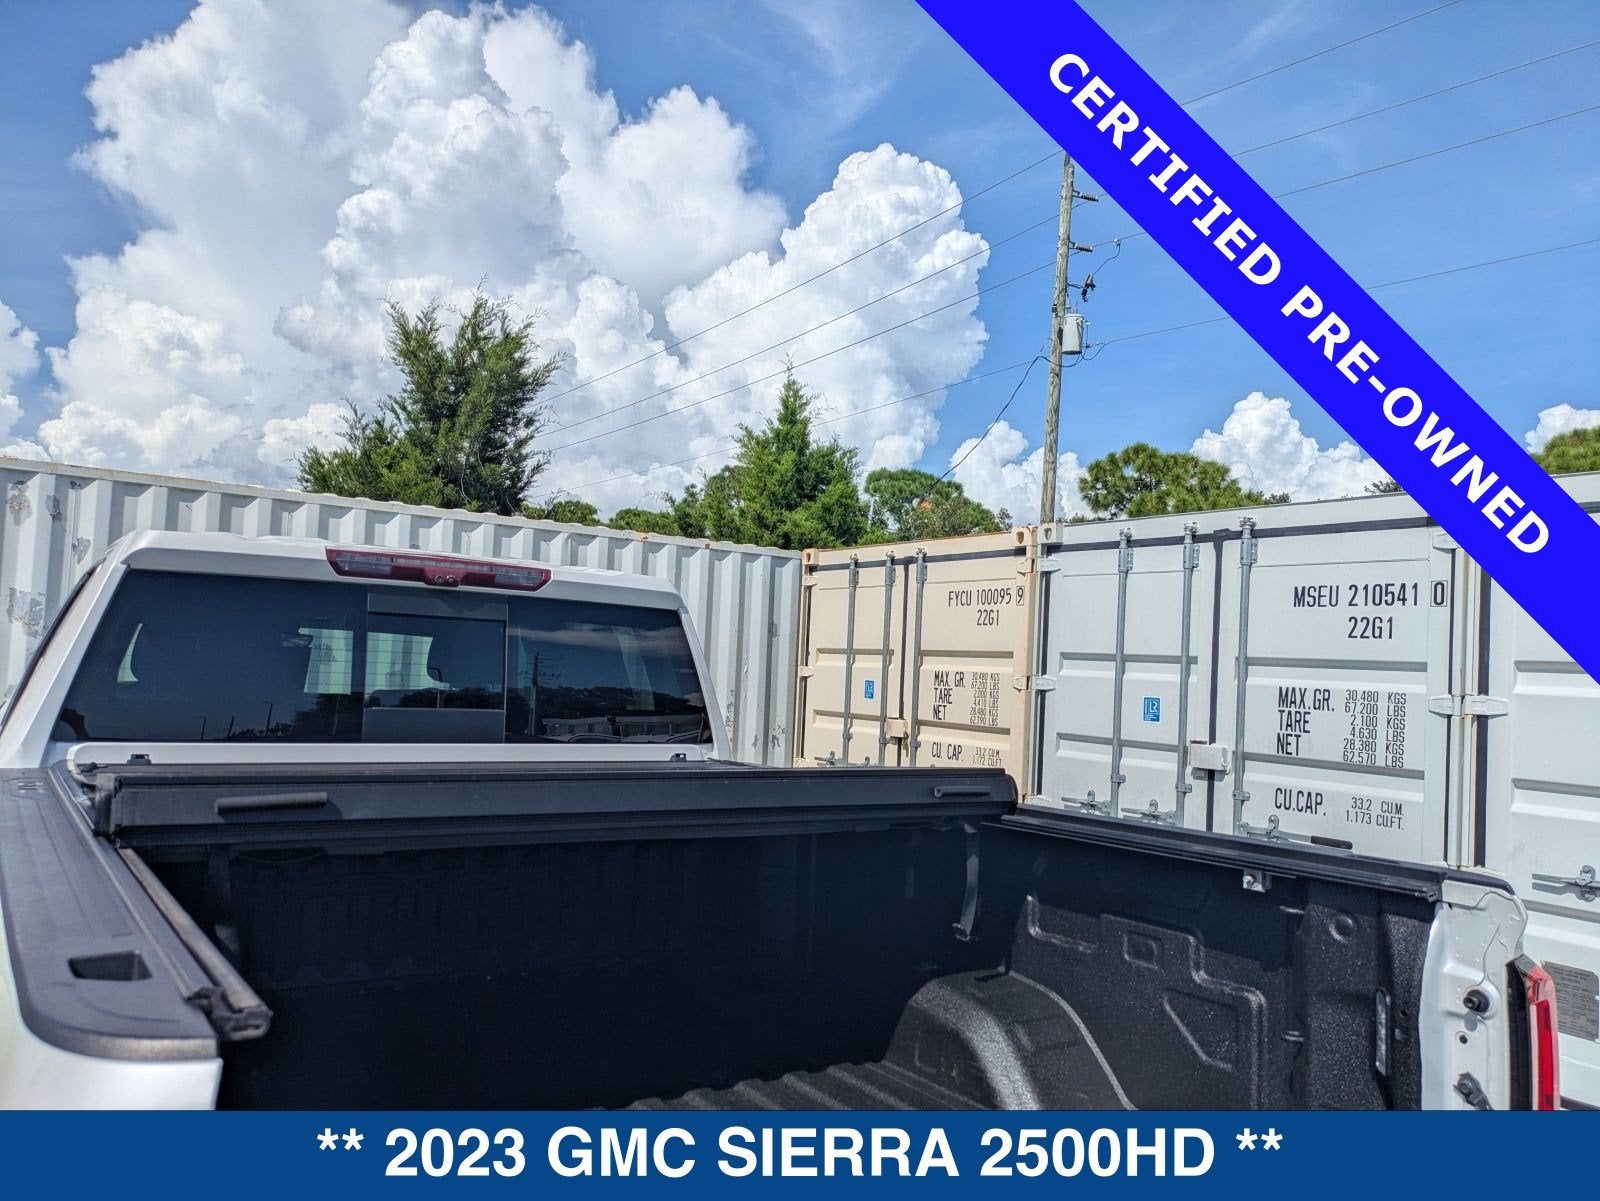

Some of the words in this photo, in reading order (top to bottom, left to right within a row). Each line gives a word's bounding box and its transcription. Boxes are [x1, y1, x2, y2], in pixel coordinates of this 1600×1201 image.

[948, 590, 972, 607] FYCU
[976, 587, 1012, 606] 100095
[1293, 585, 1340, 608] MSEU
[1347, 582, 1419, 606] 210541
[1433, 582, 1446, 606] 0
[976, 609, 1000, 626] 22G1
[1347, 616, 1394, 640] 22G1
[934, 688, 953, 704] TARE
[1345, 689, 1380, 704] 30.480
[1387, 691, 1407, 706] KGS
[933, 704, 947, 720] NET
[1344, 701, 1379, 716] 67.200
[1386, 704, 1407, 719] LBS
[1277, 709, 1312, 735] TARE
[1350, 714, 1378, 729] 2.100
[1386, 716, 1406, 731] KGS
[1349, 726, 1378, 741] 4.630
[1385, 729, 1405, 743] LBS
[932, 741, 943, 760] CU.
[1276, 732, 1302, 757] NET
[1343, 737, 1377, 753] 28.380
[1385, 741, 1405, 756] KGS
[1342, 750, 1377, 766] 62.570
[1384, 753, 1404, 769] LBS
[1274, 787, 1327, 816] CU.CAP.
[1351, 796, 1373, 812] 33.2
[1345, 810, 1372, 825] 1.173
